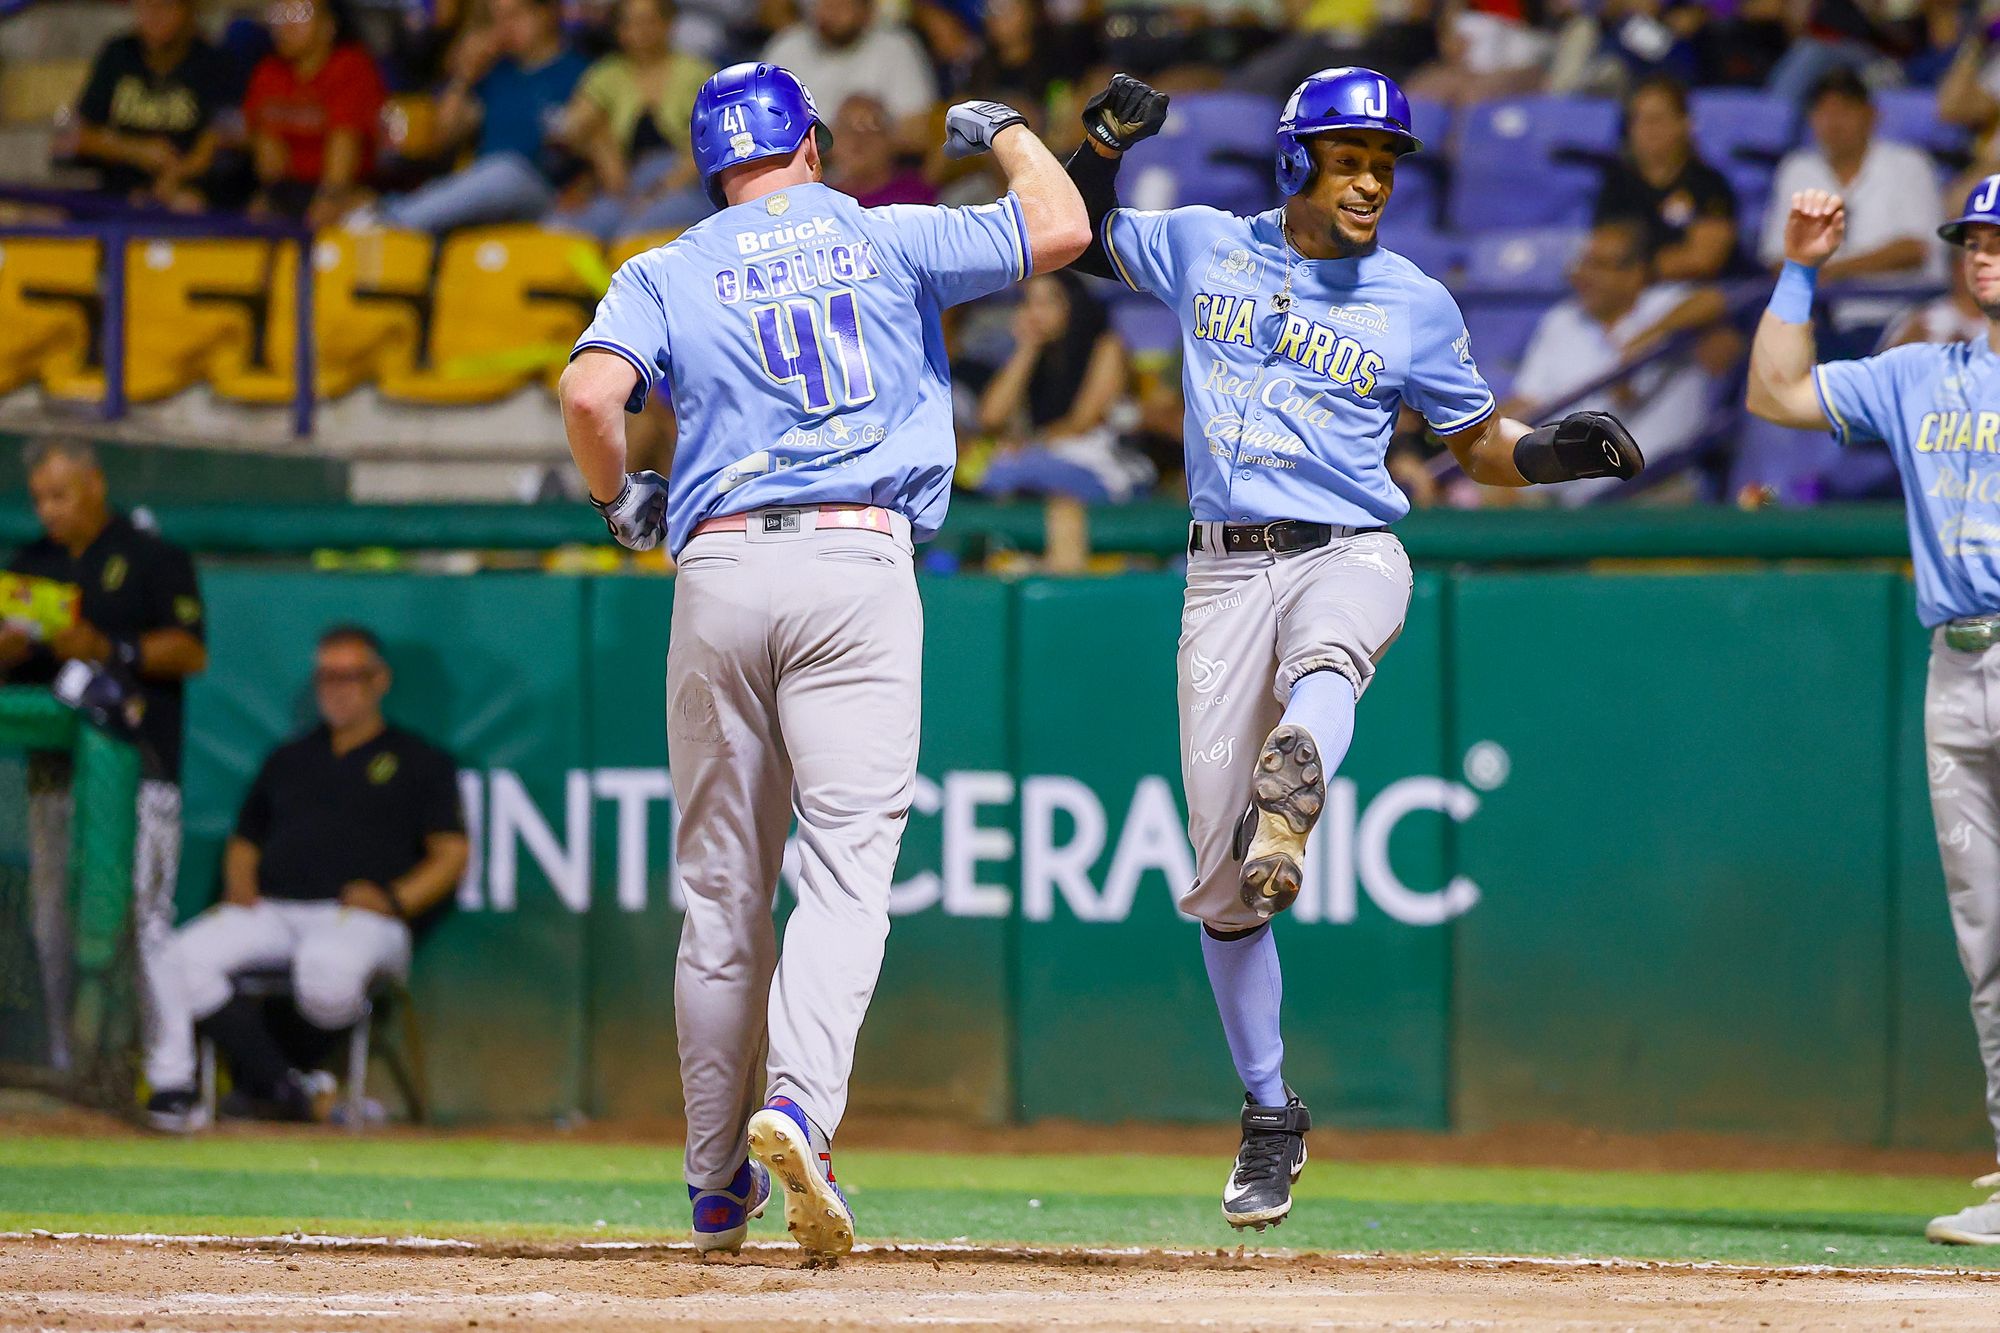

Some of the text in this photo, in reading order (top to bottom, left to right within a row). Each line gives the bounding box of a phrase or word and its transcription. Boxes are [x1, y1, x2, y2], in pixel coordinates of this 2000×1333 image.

[1365, 80, 1387, 118] J
[723, 104, 747, 134] 41
[1974, 173, 2000, 212] J
[736, 216, 840, 255] Brück
[799, 235, 842, 249] GERMANY
[714, 240, 880, 305] GARLICK
[1328, 305, 1389, 333] Electrolit
[749, 288, 877, 415] 41
[1201, 359, 1336, 429] Red Cola
[780, 428, 823, 447] obal
[1915, 409, 2000, 454] CHAR
[1184, 592, 1242, 622] Campo Azul
[1187, 734, 1236, 779] Inés
